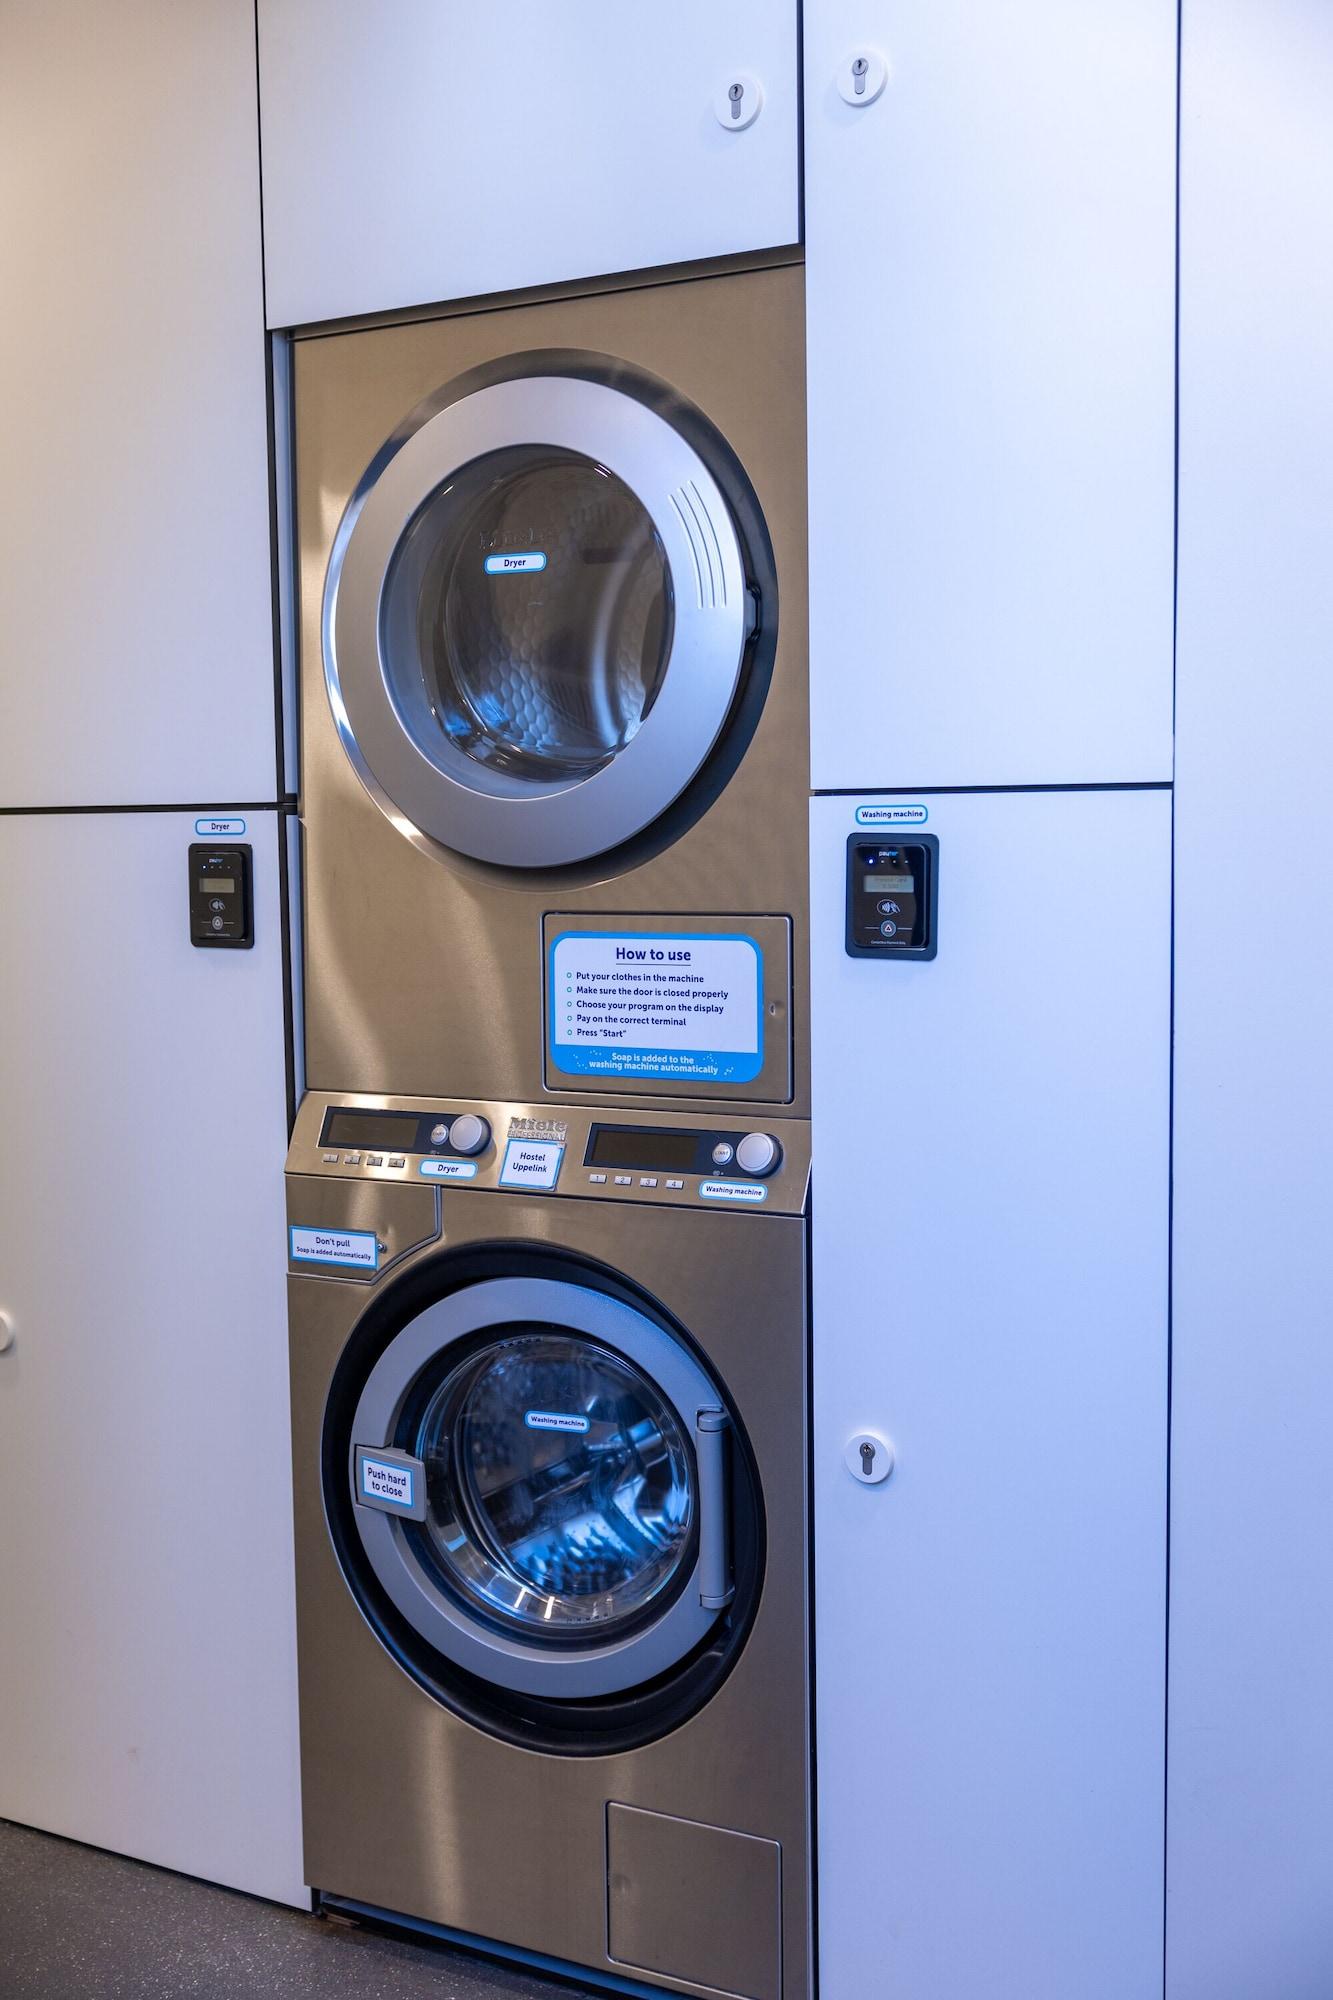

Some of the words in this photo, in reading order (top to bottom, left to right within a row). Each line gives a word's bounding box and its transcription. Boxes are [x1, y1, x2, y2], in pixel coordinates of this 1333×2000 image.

[504, 559, 526, 568] Dryer
[861, 811, 892, 819] Washing
[211, 822, 230, 831] Dryer
[616, 947, 646, 960] How
[650, 949, 664, 960] to
[668, 951, 691, 961] use
[576, 972, 590, 980] Put
[591, 974, 610, 982] your
[611, 973, 642, 981] clothes
[643, 973, 651, 982] in
[653, 974, 667, 982] the
[668, 975, 704, 983] machine
[576, 986, 598, 994] Make
[618, 987, 632, 995] the
[633, 988, 653, 996] door
[654, 988, 662, 997] is
[663, 989, 690, 998] closed
[692, 990, 729, 1000] properly
[576, 1000, 606, 1009] Choose
[607, 1002, 627, 1011] your
[628, 1003, 664, 1012] program
[665, 1004, 677, 1012] on
[678, 1003, 692, 1012] the
[693, 1004, 724, 1015] display
[576, 1014, 591, 1024] Pay
[651, 1017, 687, 1026] terminal
[576, 1028, 598, 1037] Press
[599, 1029, 627, 1038] "Start"
[611, 1052, 632, 1063] Soap
[633, 1054, 641, 1062] is
[641, 1055, 667, 1063] added
[669, 1056, 678, 1064] to
[679, 1056, 695, 1065] the
[589, 1060, 623, 1071] washing
[624, 1062, 659, 1071] machine
[660, 1065, 719, 1075] automatically
[519, 1152, 546, 1162] Hostel
[437, 1164, 459, 1173] Dryer
[512, 1162, 548, 1173] Uppelink
[706, 1186, 733, 1195] Washing
[315, 1236, 335, 1247] Don't
[336, 1239, 351, 1248] pull
[296, 1246, 310, 1254] Soap
[333, 1252, 372, 1261] automatically
[531, 1416, 558, 1425] Washing
[367, 1467, 386, 1481] Push
[387, 1472, 407, 1486] hard
[371, 1481, 381, 1491] to
[381, 1484, 403, 1497] close
